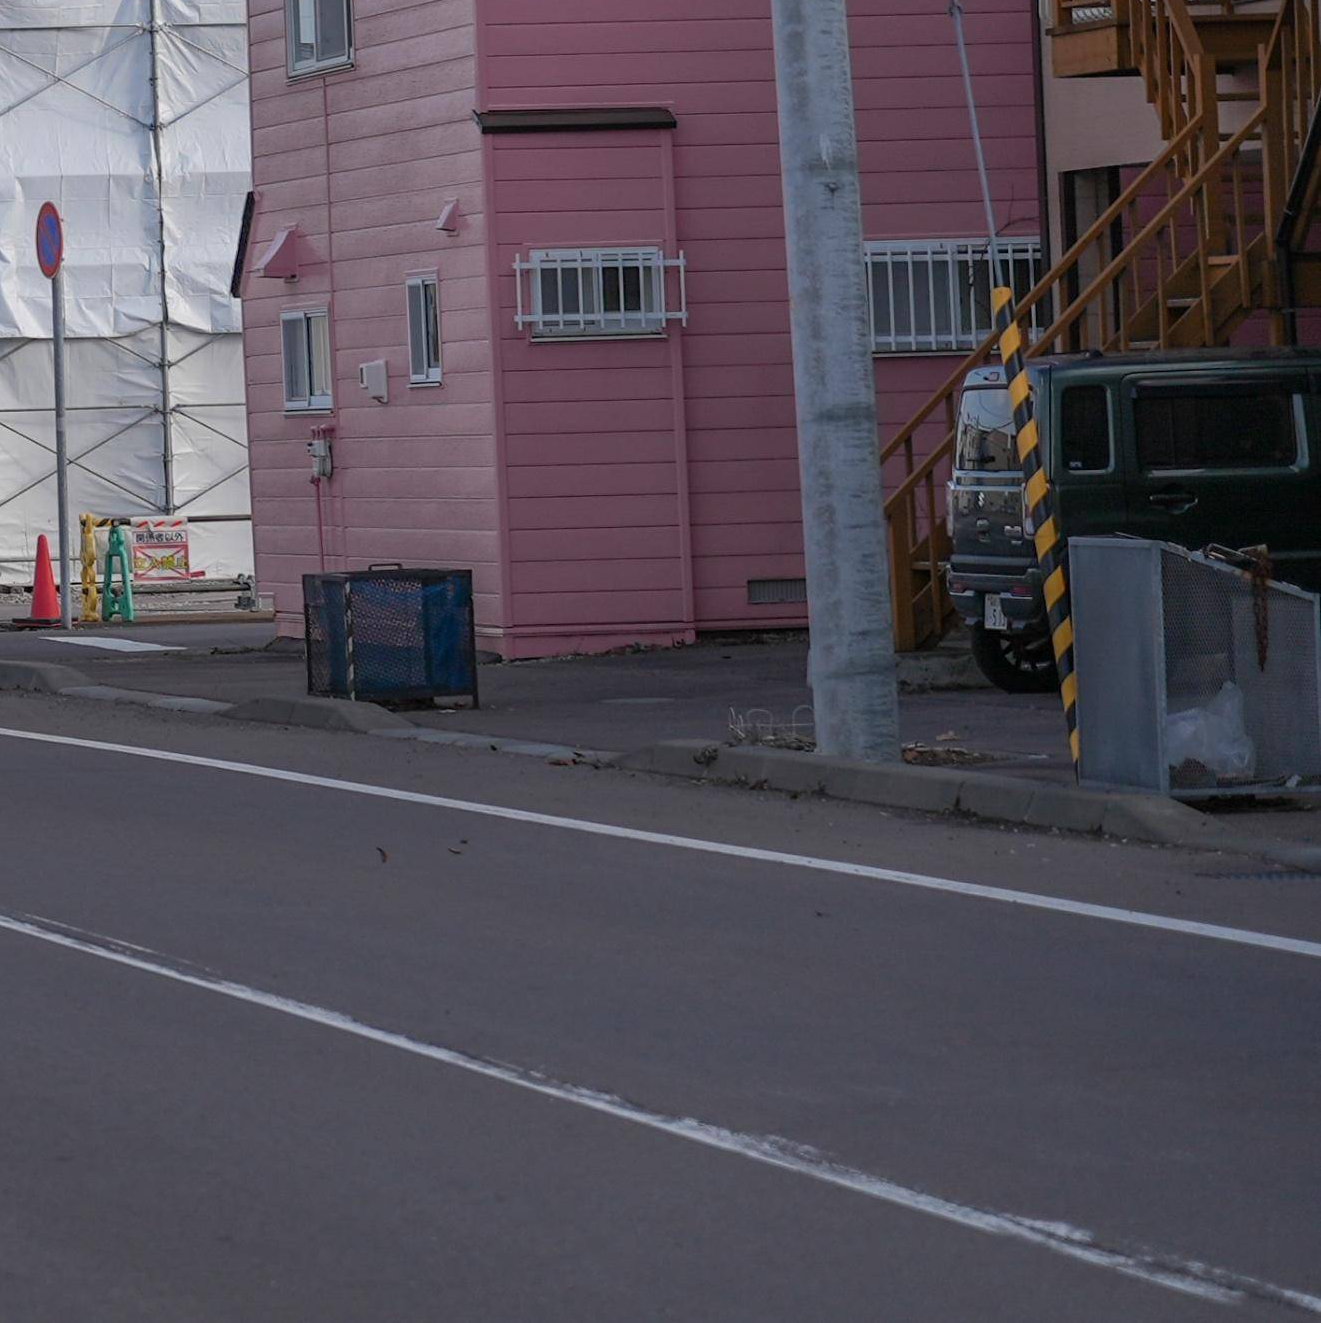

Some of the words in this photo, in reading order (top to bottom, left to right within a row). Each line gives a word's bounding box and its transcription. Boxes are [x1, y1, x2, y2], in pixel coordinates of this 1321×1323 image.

[136, 532, 183, 543] 関係者以外
